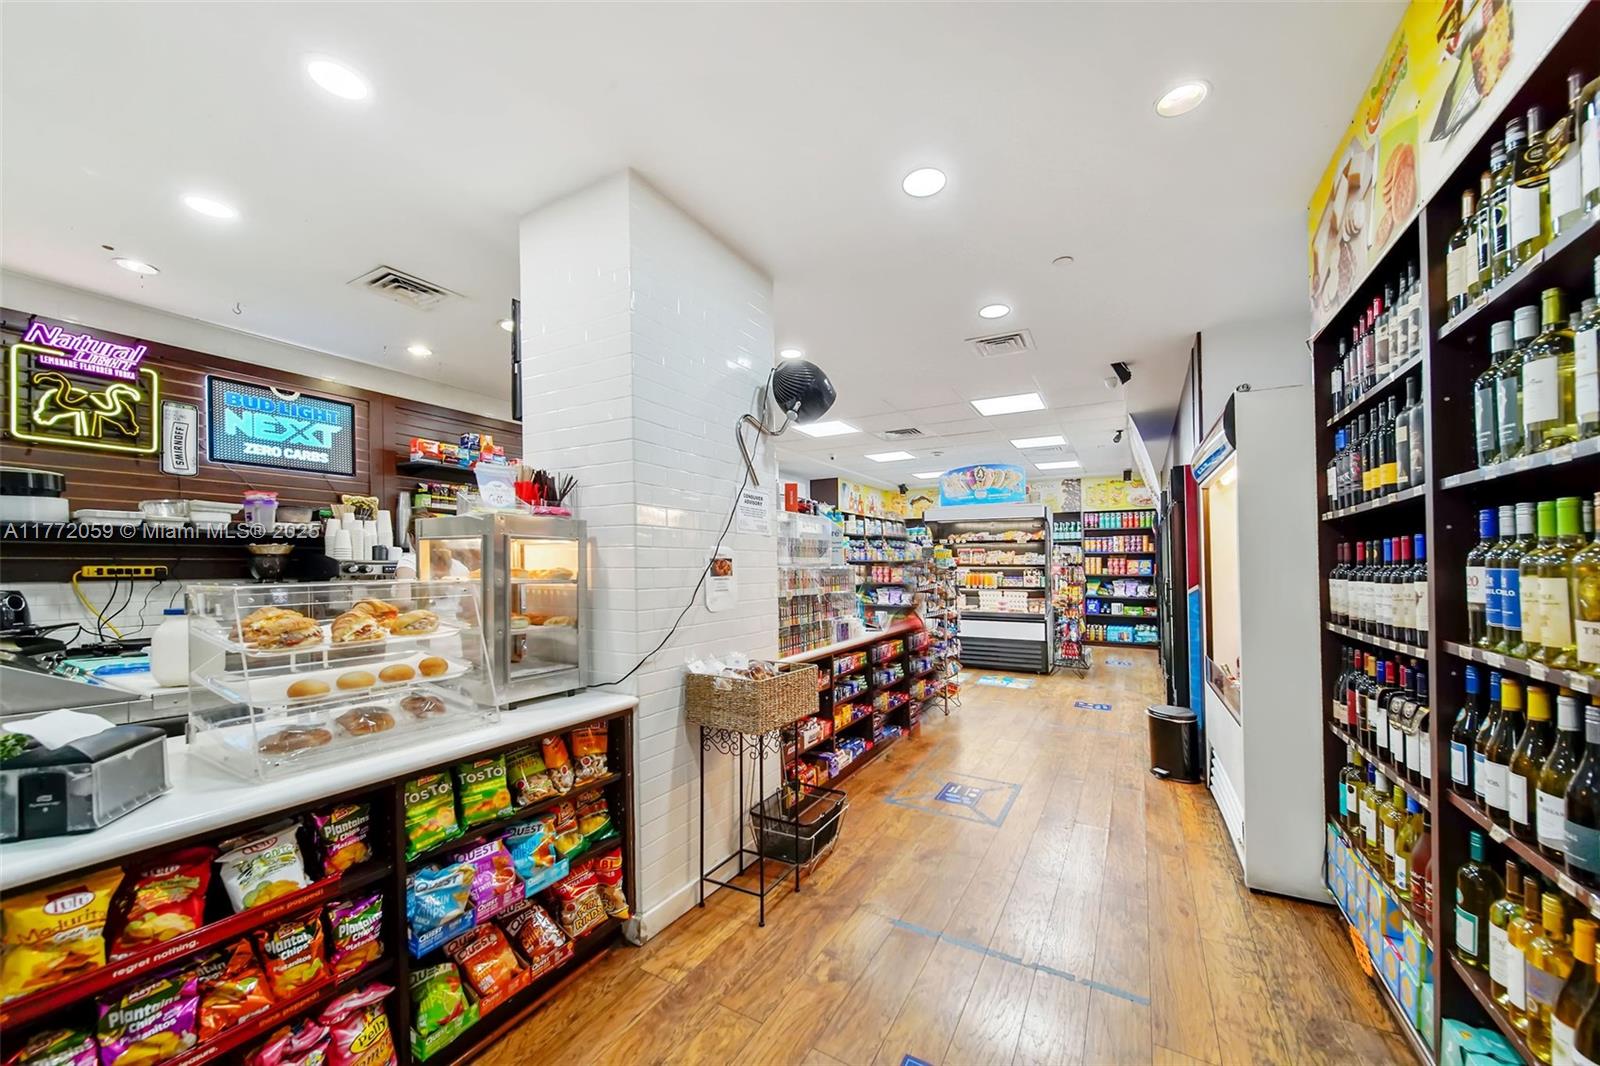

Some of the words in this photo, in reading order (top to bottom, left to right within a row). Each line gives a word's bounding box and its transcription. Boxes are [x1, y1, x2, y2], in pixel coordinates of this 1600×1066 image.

[24, 322, 147, 362] Natural
[40, 355, 79, 369] LEMONADE
[79, 362, 114, 376] FLAVORED
[114, 368, 136, 380] VODKA
[224, 391, 277, 415] BUD
[279, 402, 339, 425] LIGHT
[223, 408, 342, 450] NEXT
[175, 426, 185, 466] SMIRNOFF
[243, 442, 282, 458] ZERO
[284, 446, 330, 464] CARBS
[457, 843, 495, 863] QUEST
[287, 889, 324, 909] popped!
[112, 959, 150, 979] regret
[153, 940, 200, 962] nothing.
[281, 942, 309, 961] Chips
[108, 994, 181, 1028] Plantains
[282, 990, 320, 1016] popped!
[129, 1011, 163, 1033] Chips
[358, 1018, 387, 1047] Pelly
